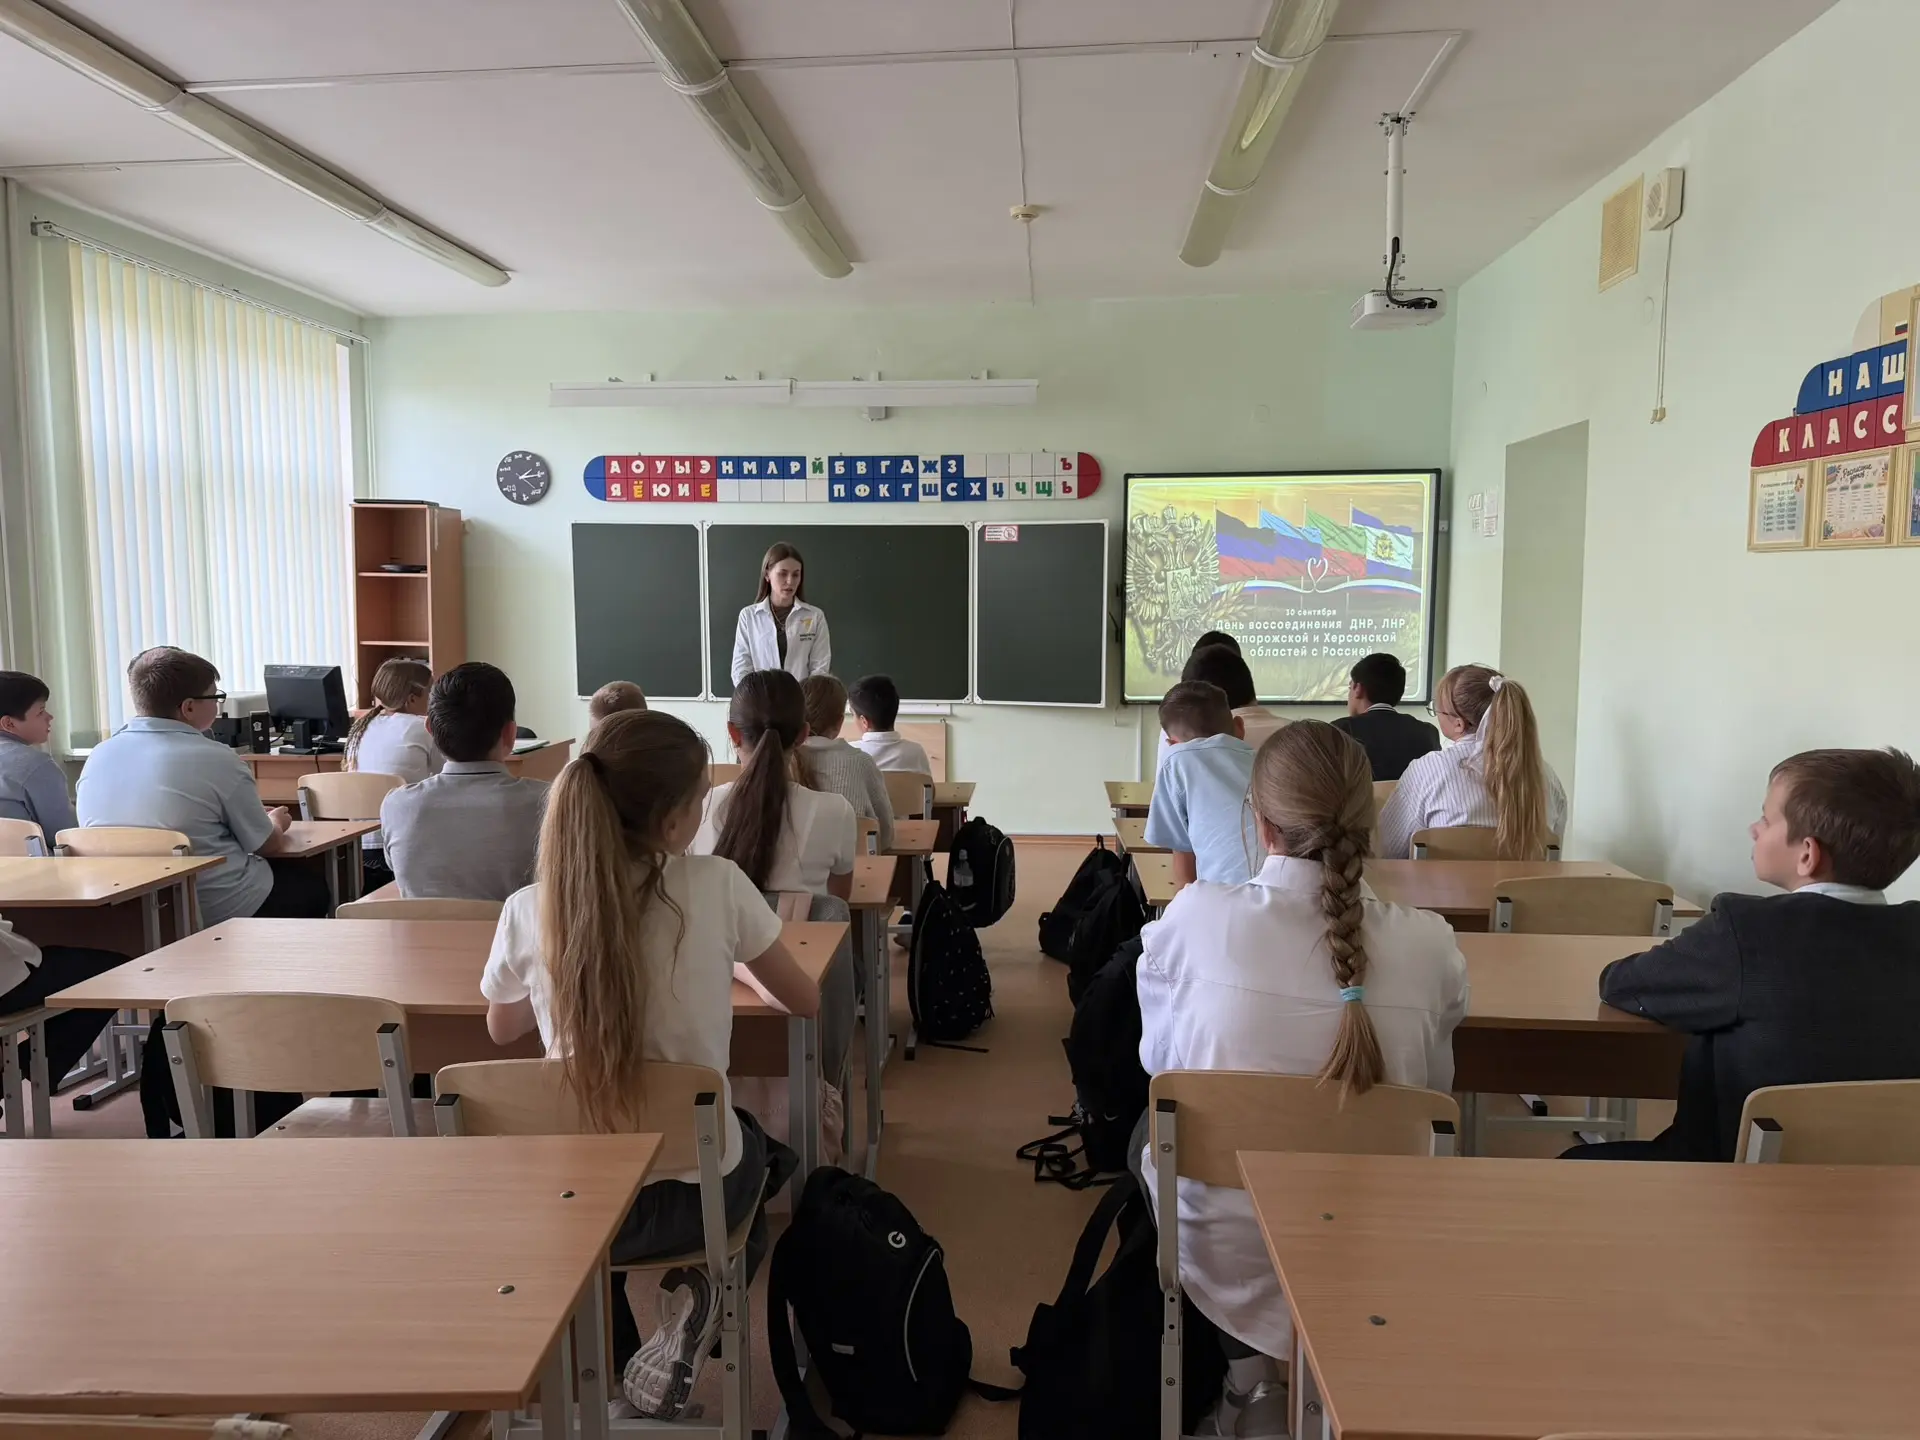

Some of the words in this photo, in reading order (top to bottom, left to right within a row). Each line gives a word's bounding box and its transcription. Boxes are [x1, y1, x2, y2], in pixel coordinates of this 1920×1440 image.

[1828, 352, 1905, 396] НАШ
[1779, 404, 1898, 452] КЛАСС
[610, 461, 620, 473] А
[631, 460, 644, 473] О
[655, 461, 666, 473] У
[675, 461, 690, 473] Ы
[700, 461, 710, 473] Э
[721, 461, 733, 473] Н
[743, 461, 757, 474] М
[767, 461, 777, 474] Л
[790, 461, 800, 474] Р
[812, 458, 823, 474] Й
[835, 461, 844, 473] Б
[857, 461, 866, 474] В
[880, 461, 890, 474] Г
[901, 460, 913, 474] Д
[922, 460, 938, 474] Ж
[948, 460, 956, 473] З
[1061, 458, 1071, 470] Ъ
[611, 484, 620, 497] Я
[633, 481, 643, 498] Ё
[653, 484, 670, 497] Ю
[679, 484, 689, 497] И
[701, 484, 710, 497] Е
[834, 484, 845, 497] П
[855, 483, 869, 497] Ф
[879, 484, 889, 497] К
[902, 484, 912, 497] Т
[922, 483, 938, 496] Ш
[946, 483, 957, 496] С
[970, 483, 980, 496] Х
[993, 483, 1003, 498] Ц
[1016, 482, 1026, 494] Ч
[1036, 481, 1052, 496] Щ
[1062, 481, 1072, 493] Ь
[1297, 608, 1337, 617] сентября
[1215, 620, 1245, 631] День
[1248, 620, 1342, 631] воссоединения
[1349, 618, 1377, 630] ДНР,
[1381, 618, 1409, 630] ЛНР,
[1235, 632, 1308, 645] апорожской
[1313, 634, 1319, 642] и
[1323, 632, 1397, 644] Херсонской
[1249, 646, 1307, 657] областей
[1311, 648, 1318, 656] с
[1322, 646, 1373, 656] Россией
